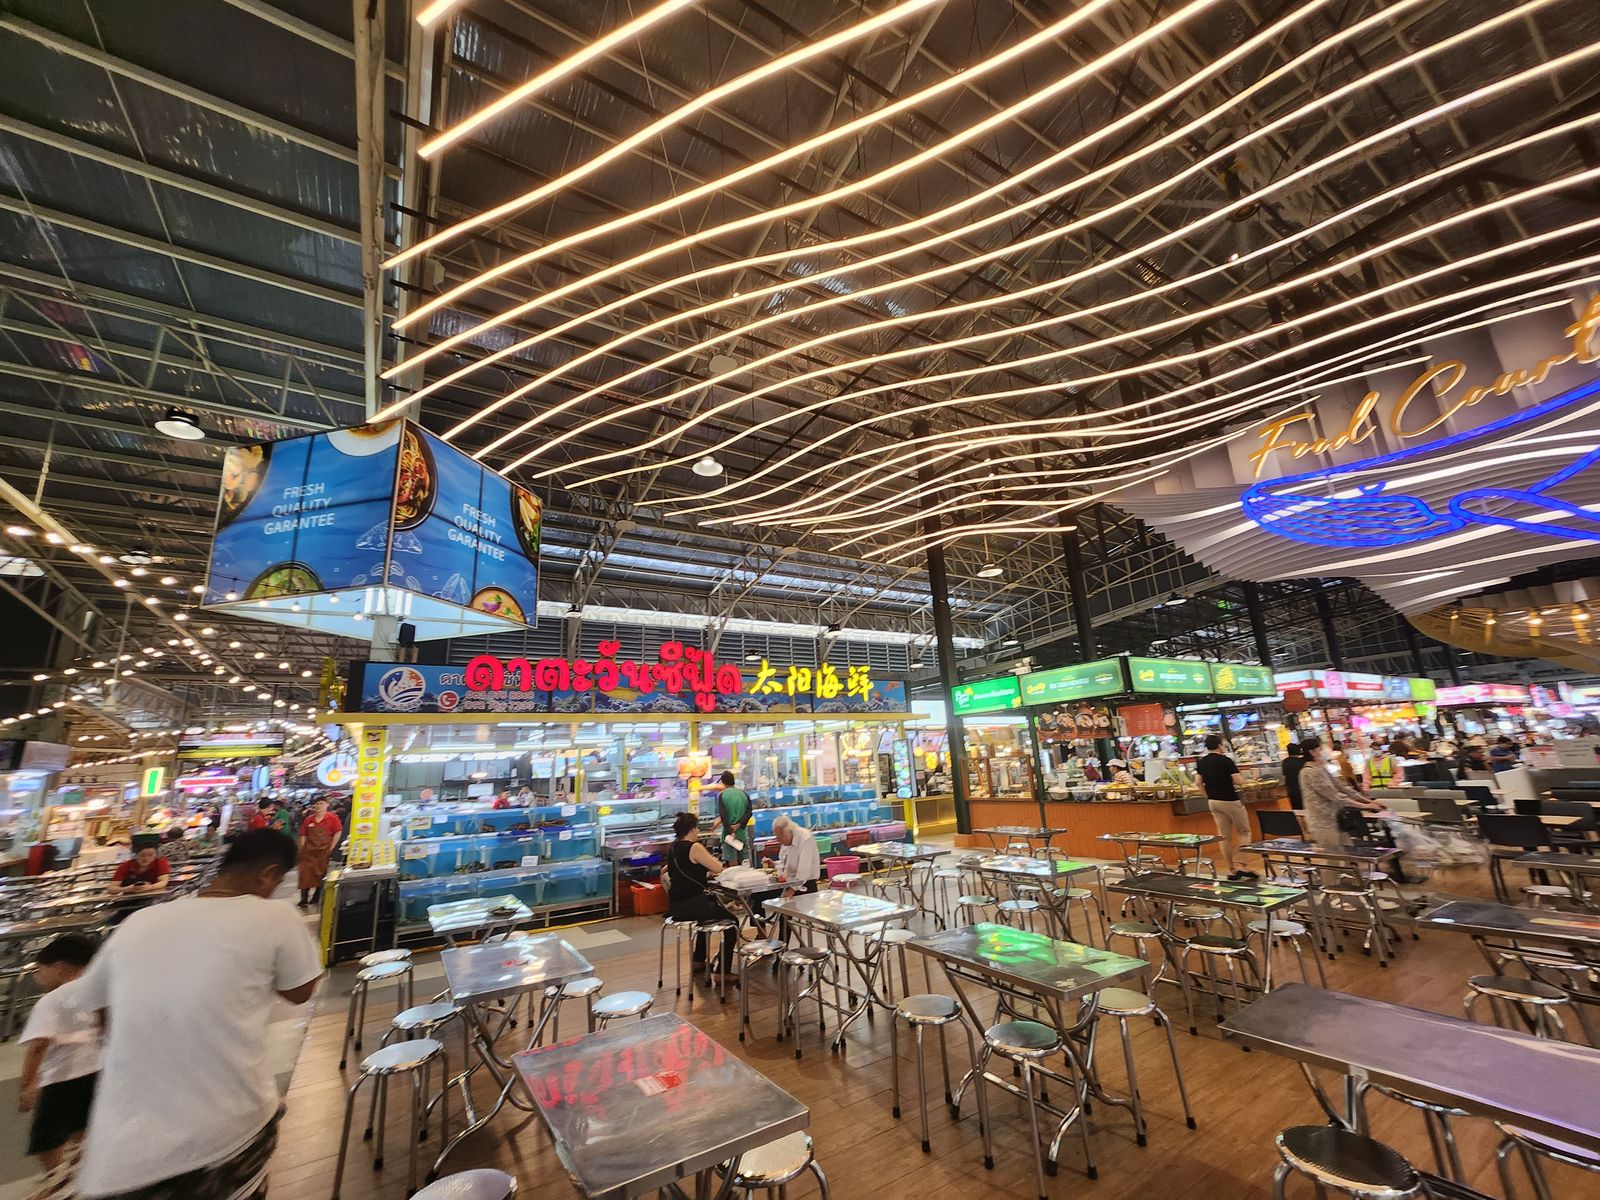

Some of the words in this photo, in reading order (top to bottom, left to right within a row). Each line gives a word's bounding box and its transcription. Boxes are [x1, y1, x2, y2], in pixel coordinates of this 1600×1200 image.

[1247, 390, 1378, 477] Food
[1391, 290, 1600, 438] Court
[283, 482, 325, 499] FRESH
[272, 497, 332, 517] QUALITY
[463, 503, 496, 528] FRESH
[264, 513, 335, 535] GARANTEE
[454, 515, 502, 544] QUALITY
[448, 528, 505, 561] GARANTEE
[749, 658, 875, 702] 太阳海鲜
